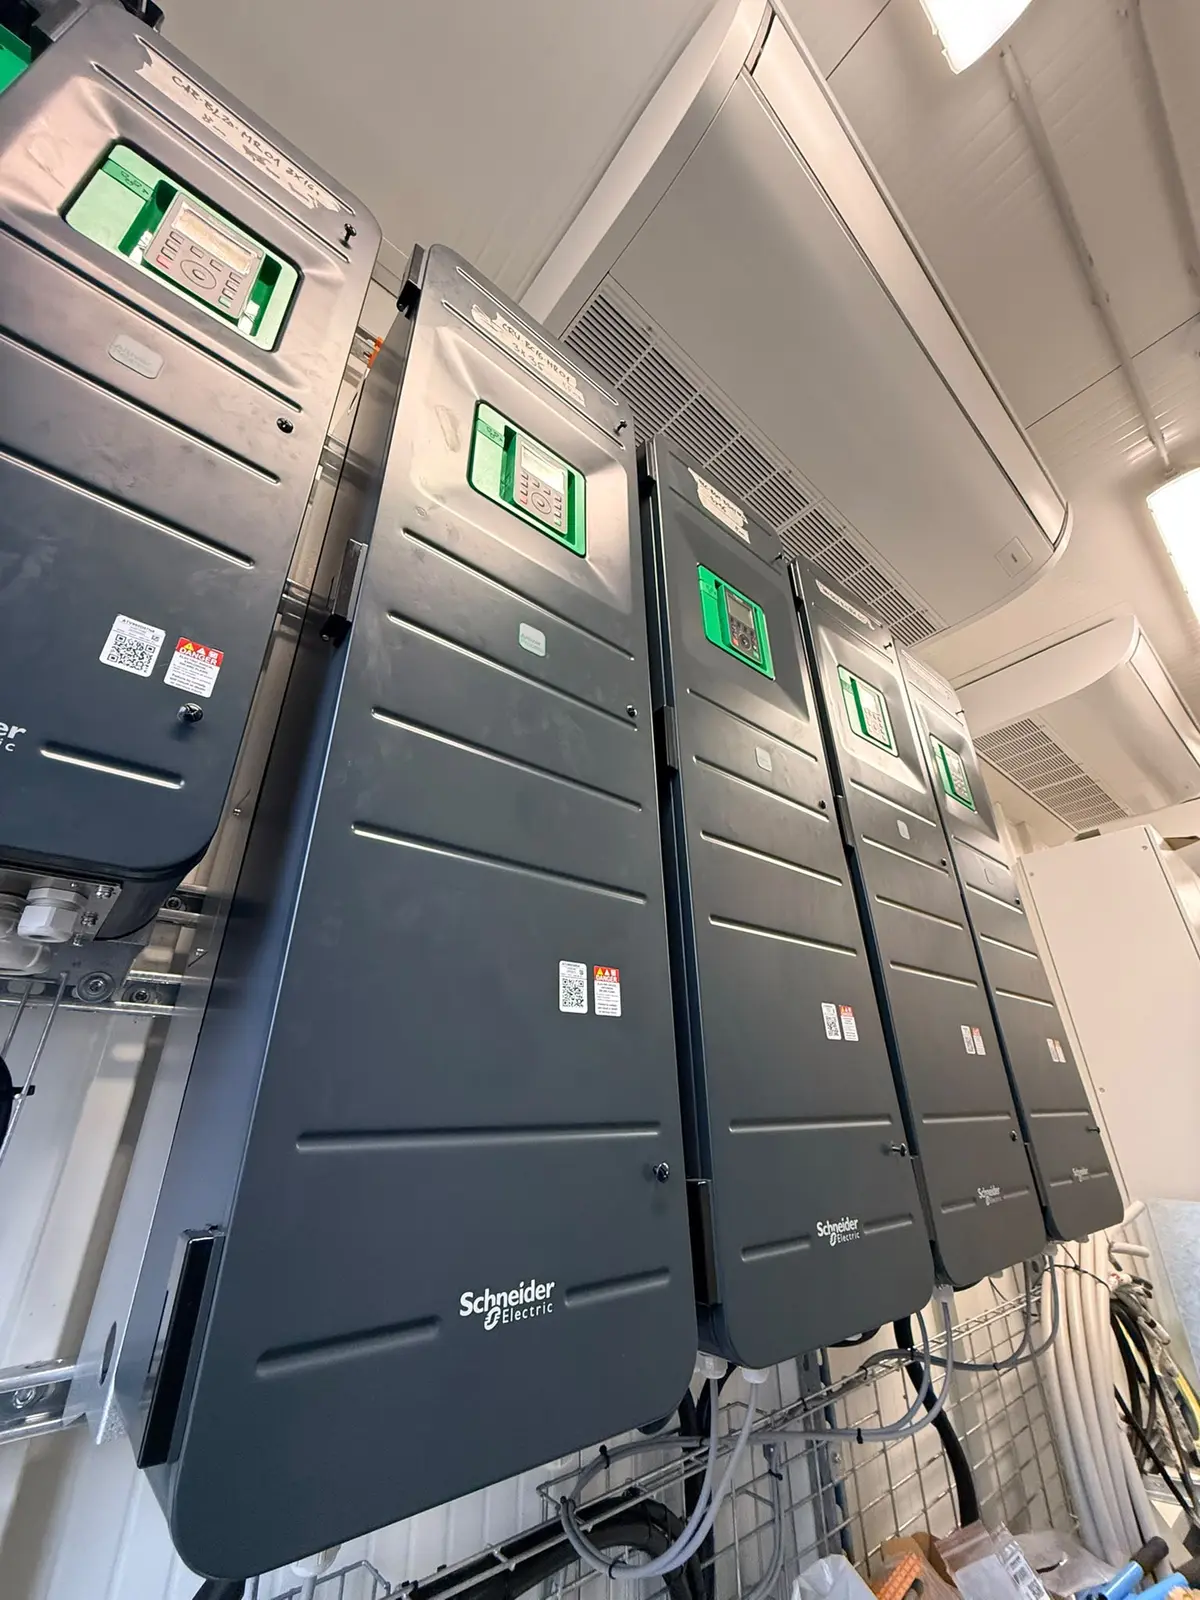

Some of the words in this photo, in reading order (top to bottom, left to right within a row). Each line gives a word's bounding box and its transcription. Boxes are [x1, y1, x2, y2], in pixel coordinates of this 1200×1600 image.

[178, 647, 219, 666] DANGER
[816, 1216, 859, 1237] Schneider
[837, 1231, 861, 1244] Electric
[460, 1279, 555, 1317] Schneider
[502, 1301, 554, 1324] Electric
